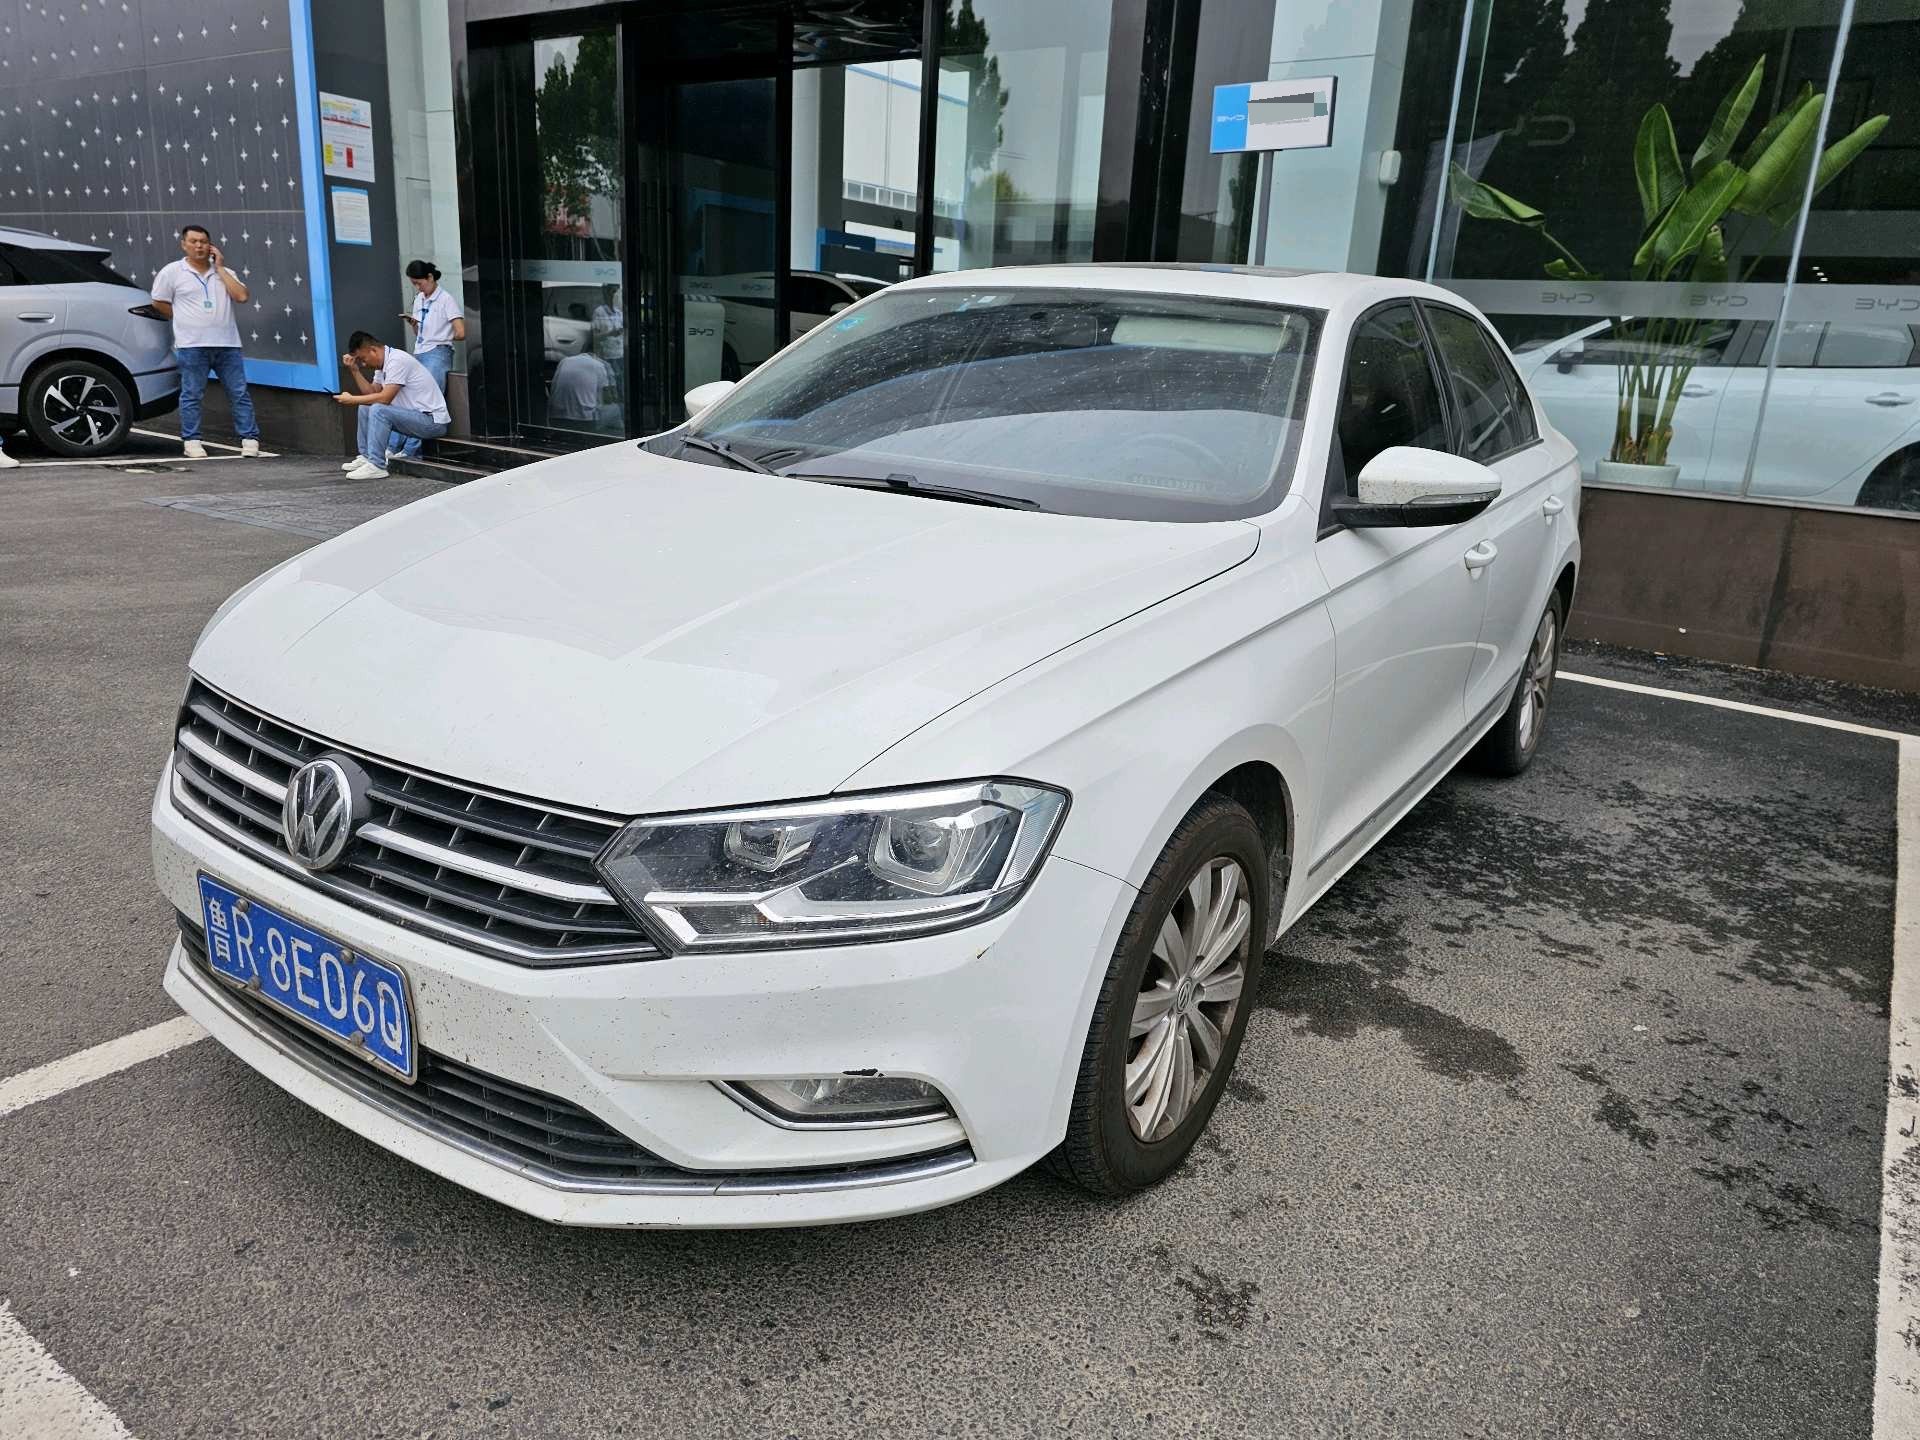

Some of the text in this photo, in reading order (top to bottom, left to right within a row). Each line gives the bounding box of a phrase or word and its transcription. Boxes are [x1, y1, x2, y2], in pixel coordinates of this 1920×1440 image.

[1541, 292, 1595, 304] BYD
[1689, 295, 1749, 308] BYD
[1855, 298, 1920, 311] BYD
[688, 327, 714, 337] BYD
